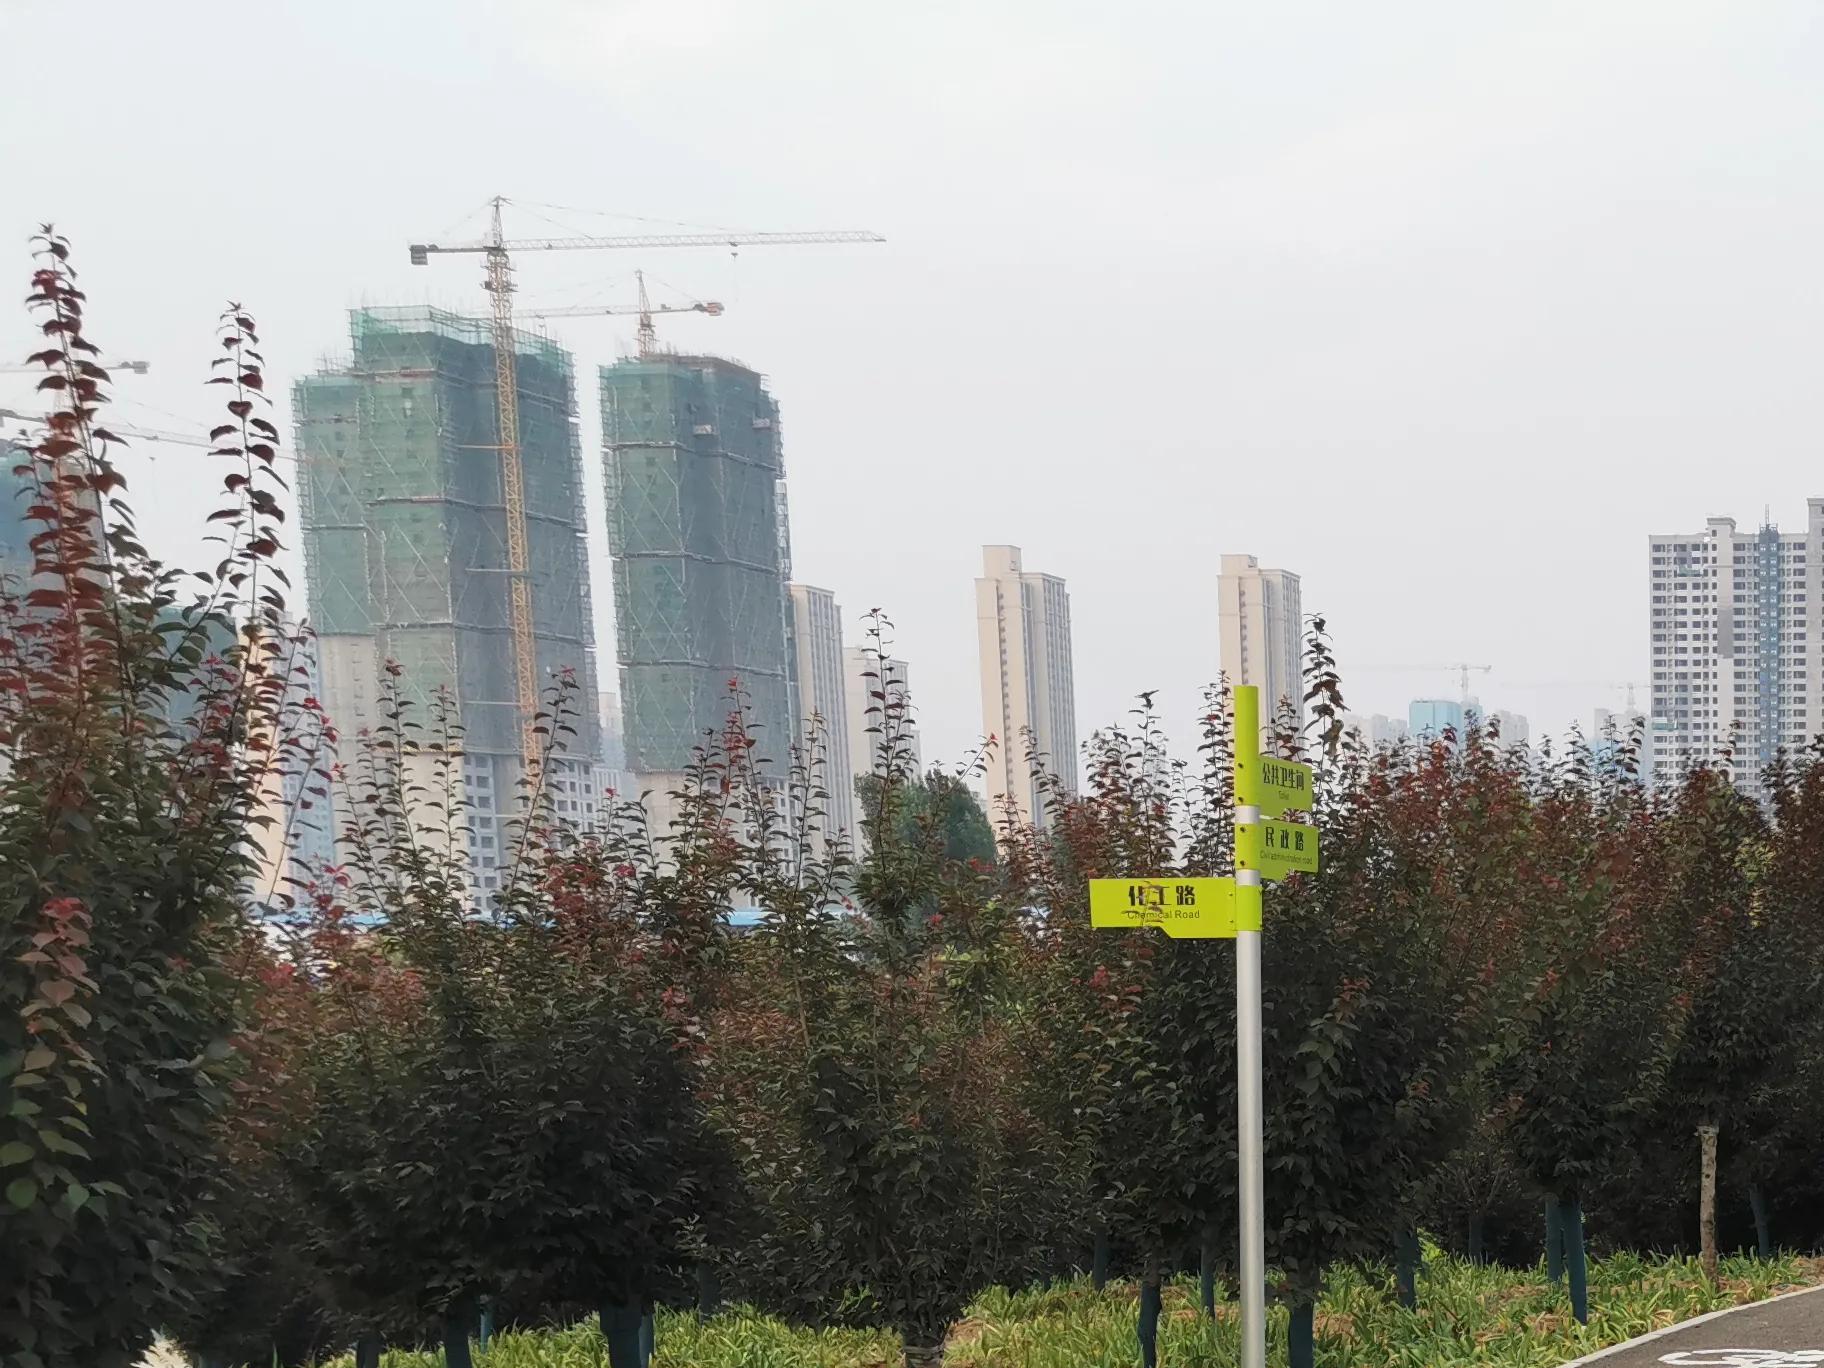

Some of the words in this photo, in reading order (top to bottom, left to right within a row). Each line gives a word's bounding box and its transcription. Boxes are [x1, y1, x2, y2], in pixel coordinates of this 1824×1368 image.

[1263, 762, 1304, 791] 公共卫生间
[1265, 826, 1304, 851] 民政路
[1129, 885, 1195, 906] 化工路
[1174, 910, 1200, 919] Road
